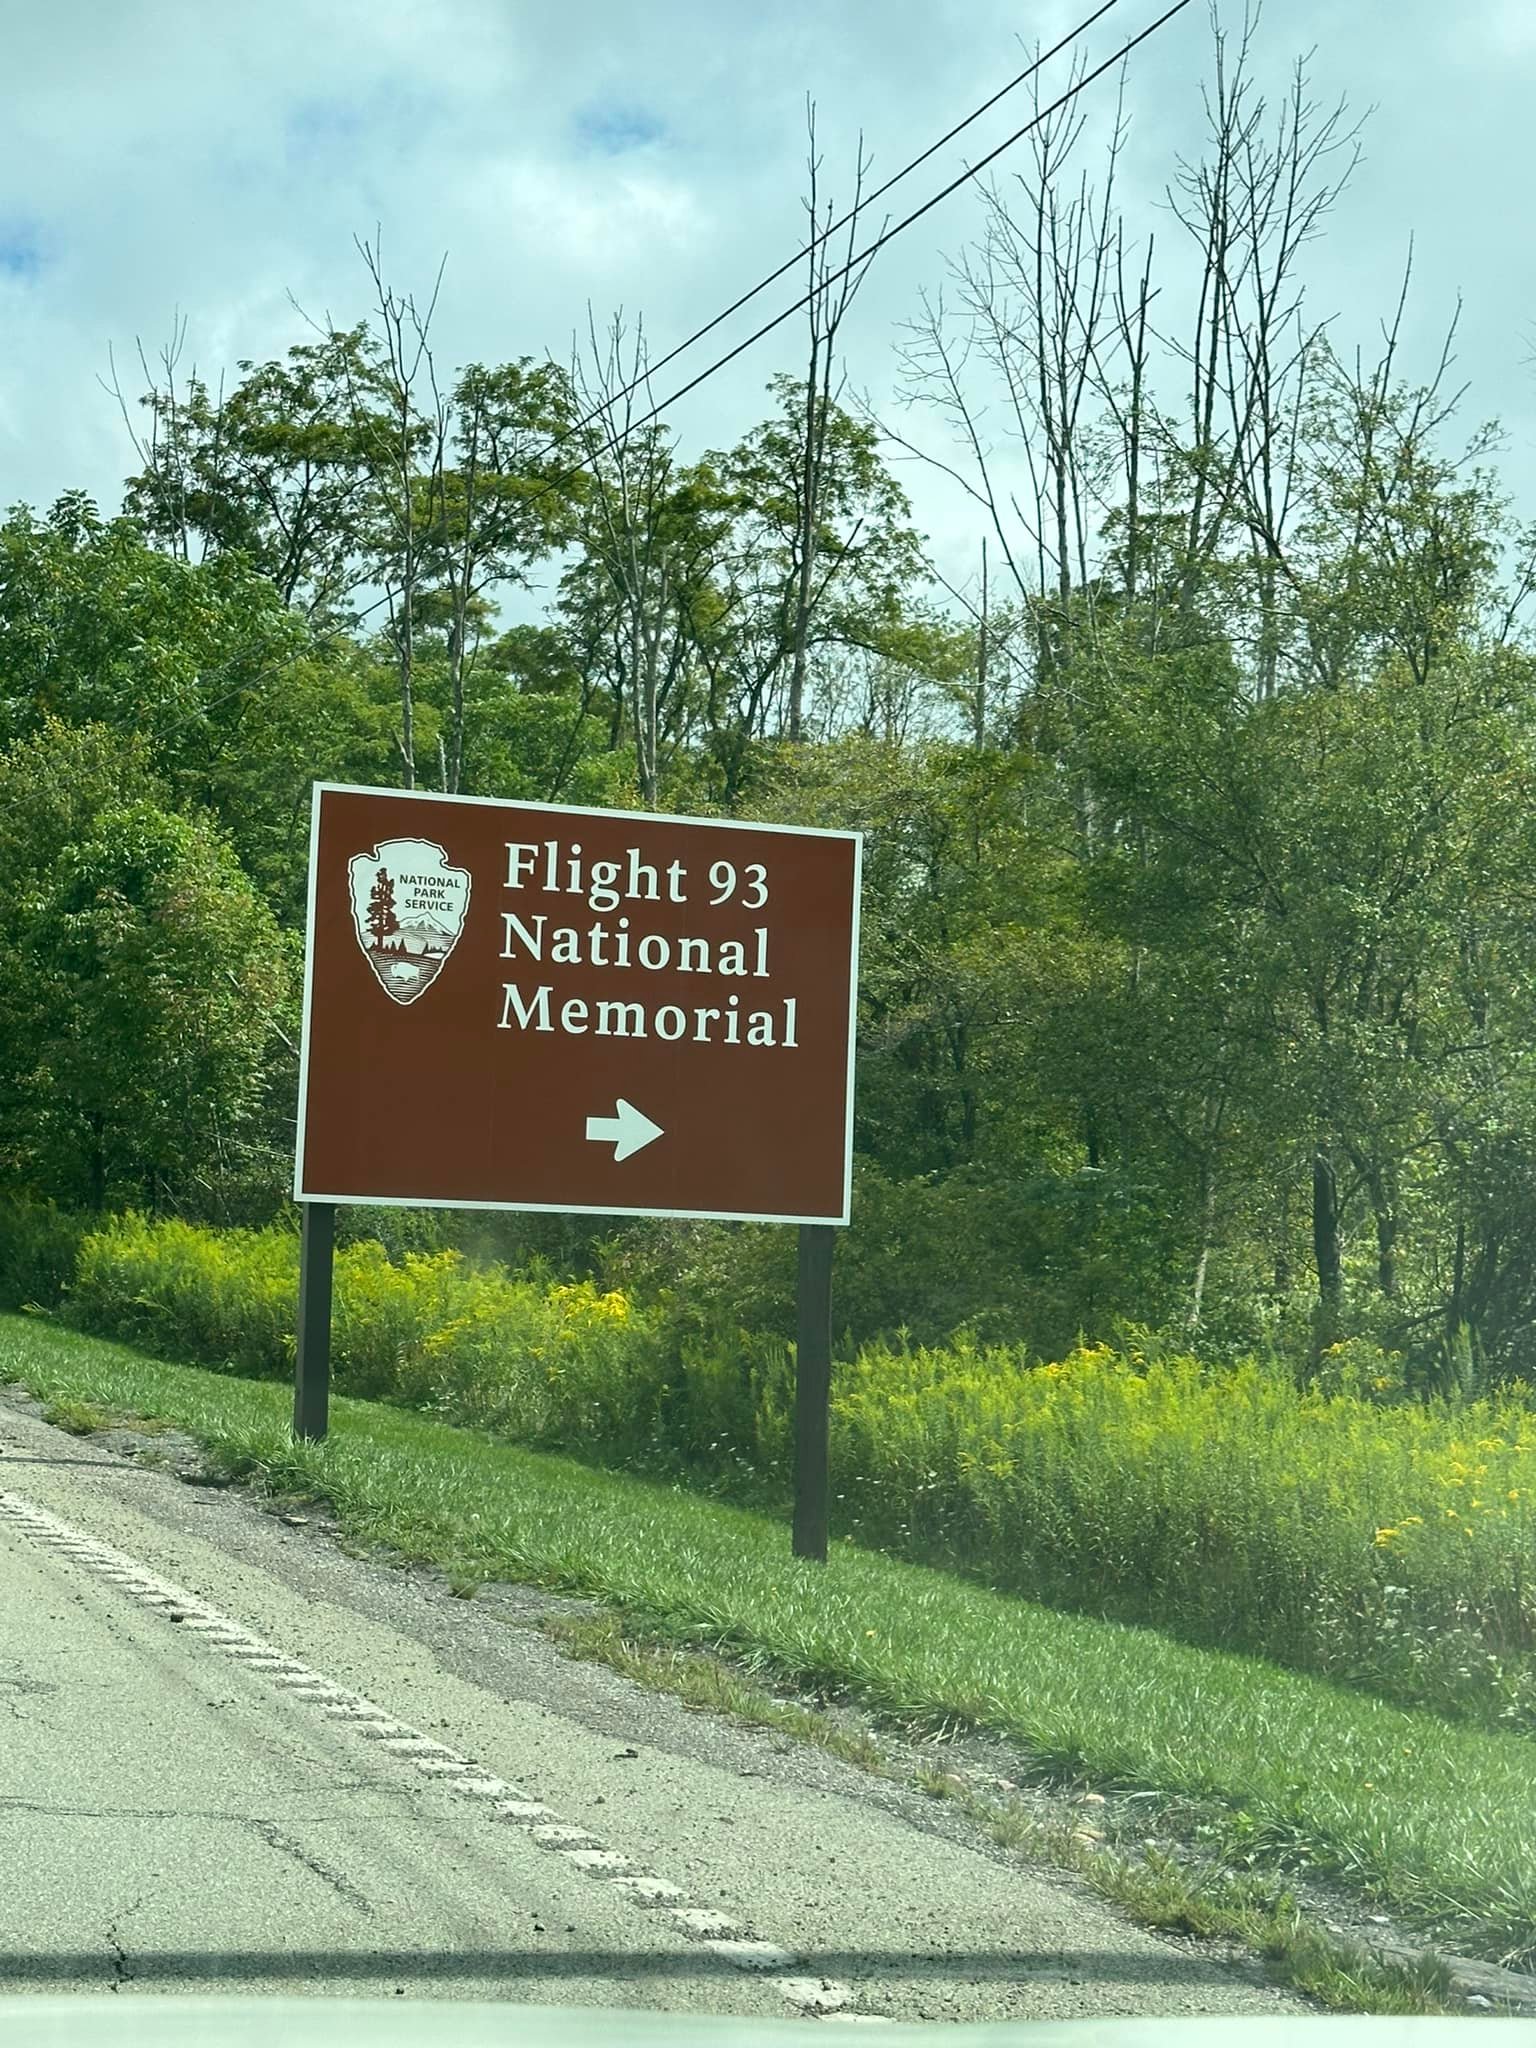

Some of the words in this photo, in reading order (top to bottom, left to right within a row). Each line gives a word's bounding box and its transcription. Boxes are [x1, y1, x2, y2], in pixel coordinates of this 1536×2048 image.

[399, 873, 461, 889] NATIONAL
[413, 887, 446, 899] PARK
[503, 840, 688, 912] Flight
[708, 860, 769, 909] 93
[404, 898, 455, 912] SERVICE
[499, 912, 770, 977] National
[496, 983, 799, 1048] Memorial
